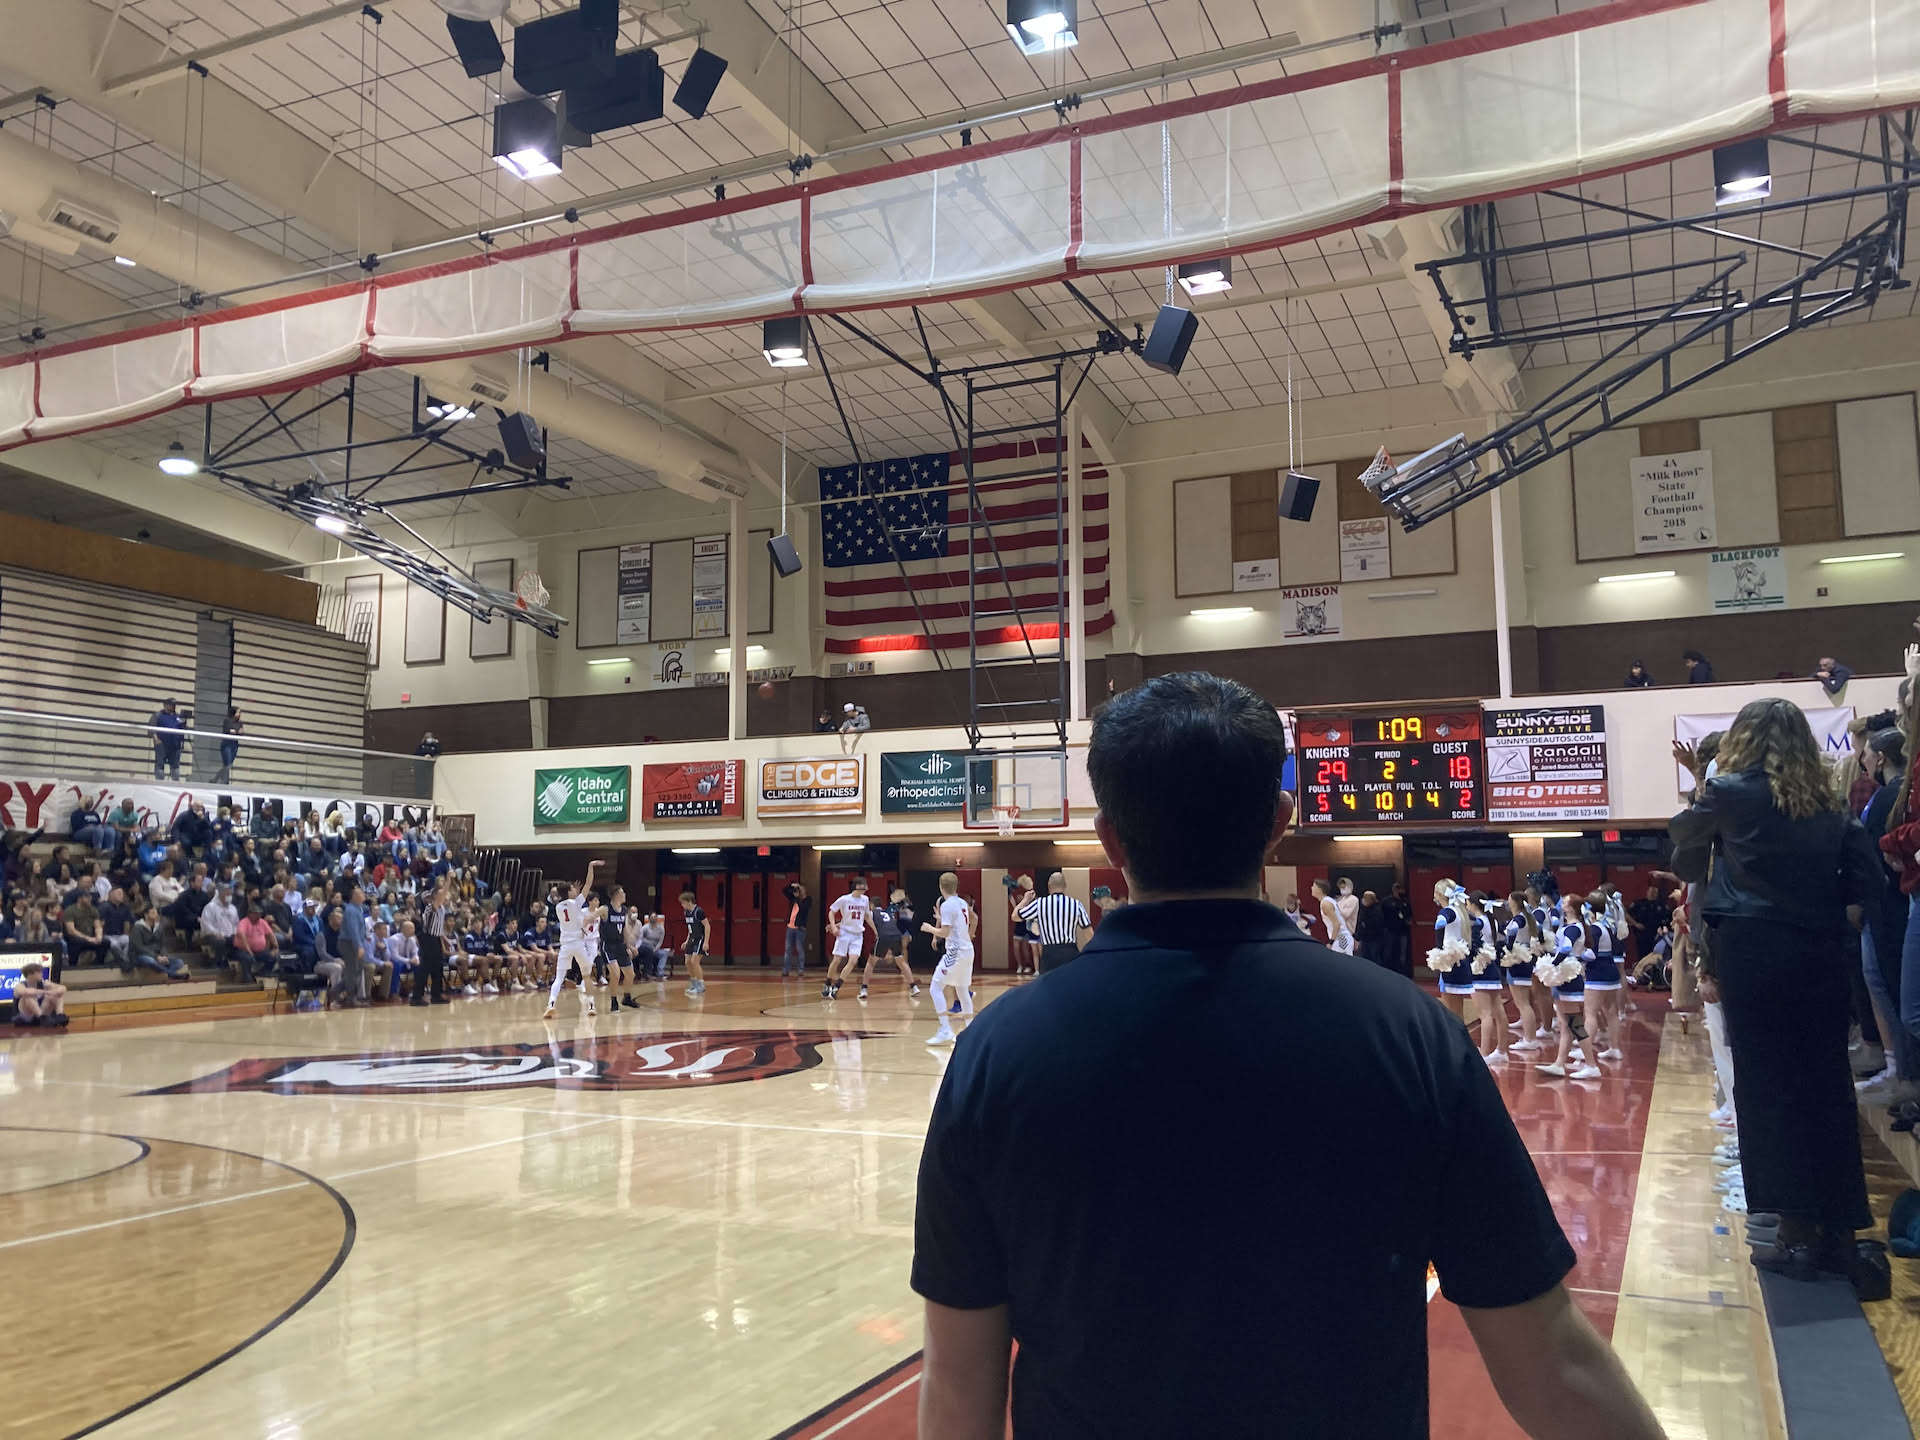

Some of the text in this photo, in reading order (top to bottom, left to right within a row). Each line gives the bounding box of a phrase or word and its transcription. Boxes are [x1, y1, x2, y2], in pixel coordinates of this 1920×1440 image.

[1663, 459, 1678, 468] 4A
[1658, 482, 1686, 491] State
[1651, 491, 1695, 503] Football
[1644, 504, 1704, 516] Champions
[1663, 518, 1686, 528] 2018
[1711, 547, 1779, 563] BLACKFOOT
[1282, 586, 1339, 600] MADISON
[658, 641, 687, 651] RIGBY
[1495, 714, 1592, 728] SUNNYSIDE
[1378, 717, 1422, 741] 1:09
[1497, 725, 1591, 736] AUTOMOTIVE
[1496, 735, 1594, 745] SUNNYSIDEAUTOS.COM
[1305, 747, 1350, 759] KNIGHTS
[1433, 742, 1468, 754] GUEST
[1533, 744, 1601, 757] Randall
[1374, 750, 1401, 759] PERIOD
[1317, 760, 1347, 784] 29
[1383, 760, 1395, 780] 2
[1449, 755, 1471, 779] 18
[767, 766, 775, 787] the
[775, 762, 857, 788] EDGE
[577, 776, 612, 790] Idaho
[724, 759, 736, 805] HILLCREST
[1308, 780, 1474, 793] FOULS T.O.L. PLAYER FOUL T.O.L. FOULS
[577, 789, 624, 804] Central
[766, 787, 855, 799] CLIMBING & FITNESS
[1493, 786, 1526, 797] BIG
[1545, 784, 1602, 795] TIRES
[657, 800, 716, 810] Randall
[1317, 788, 1472, 812] 5 4 10 1 4 2
[576, 805, 623, 814] CREDIT UNION
[656, 808, 718, 816] orthodontics
[1309, 810, 1476, 822] SCORE MATCH SCORE
